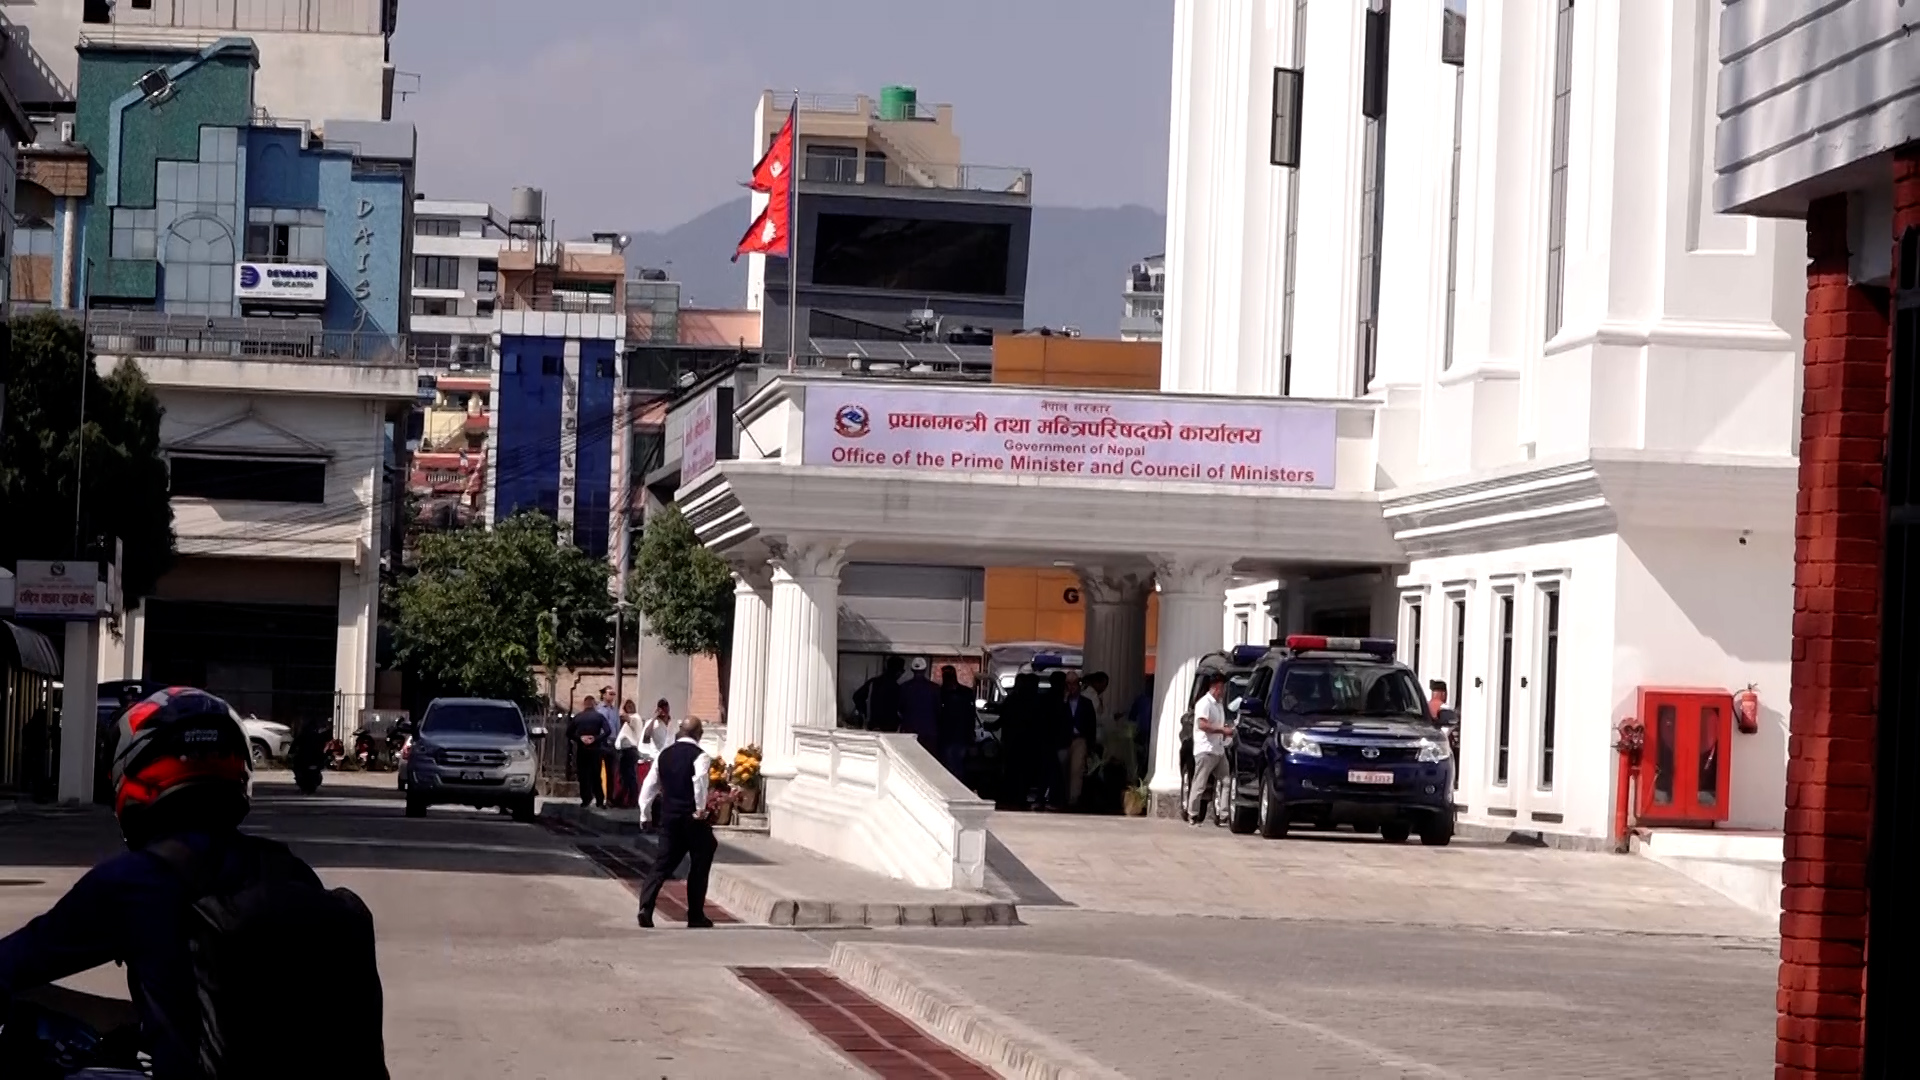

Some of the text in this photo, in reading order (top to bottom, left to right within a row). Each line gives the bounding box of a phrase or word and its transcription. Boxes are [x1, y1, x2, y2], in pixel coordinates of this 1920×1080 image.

[1041, 400, 1111, 413] नेपाल सरकार
[888, 411, 1262, 444] प्रधानमन्त्री तथा मन्त्रिपरिषदको कार्यालय
[1004, 439, 1145, 458] Government of Nepal
[831, 447, 1315, 483] Office of the Prime Minister and Council of Ministers
